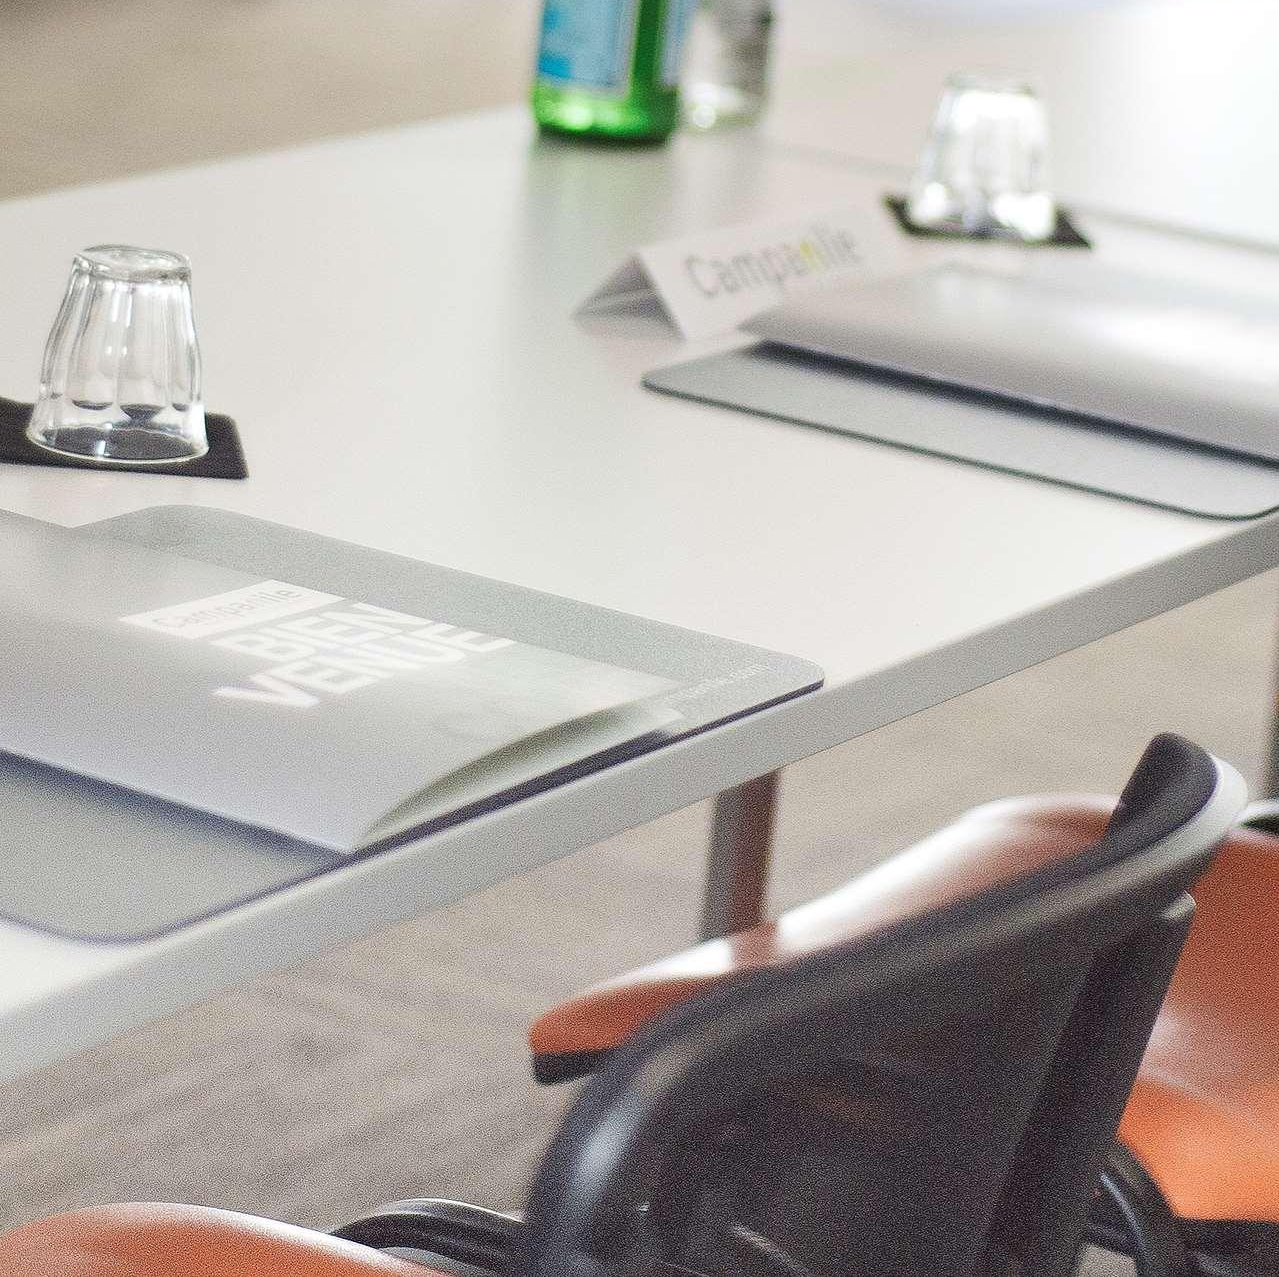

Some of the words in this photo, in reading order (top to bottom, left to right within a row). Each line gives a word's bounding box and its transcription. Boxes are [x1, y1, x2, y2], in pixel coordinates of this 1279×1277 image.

[685, 224, 864, 299] Campanile
[152, 588, 304, 629] Campanile
[209, 602, 433, 662] BIEN
[212, 622, 518, 708] VENUE
